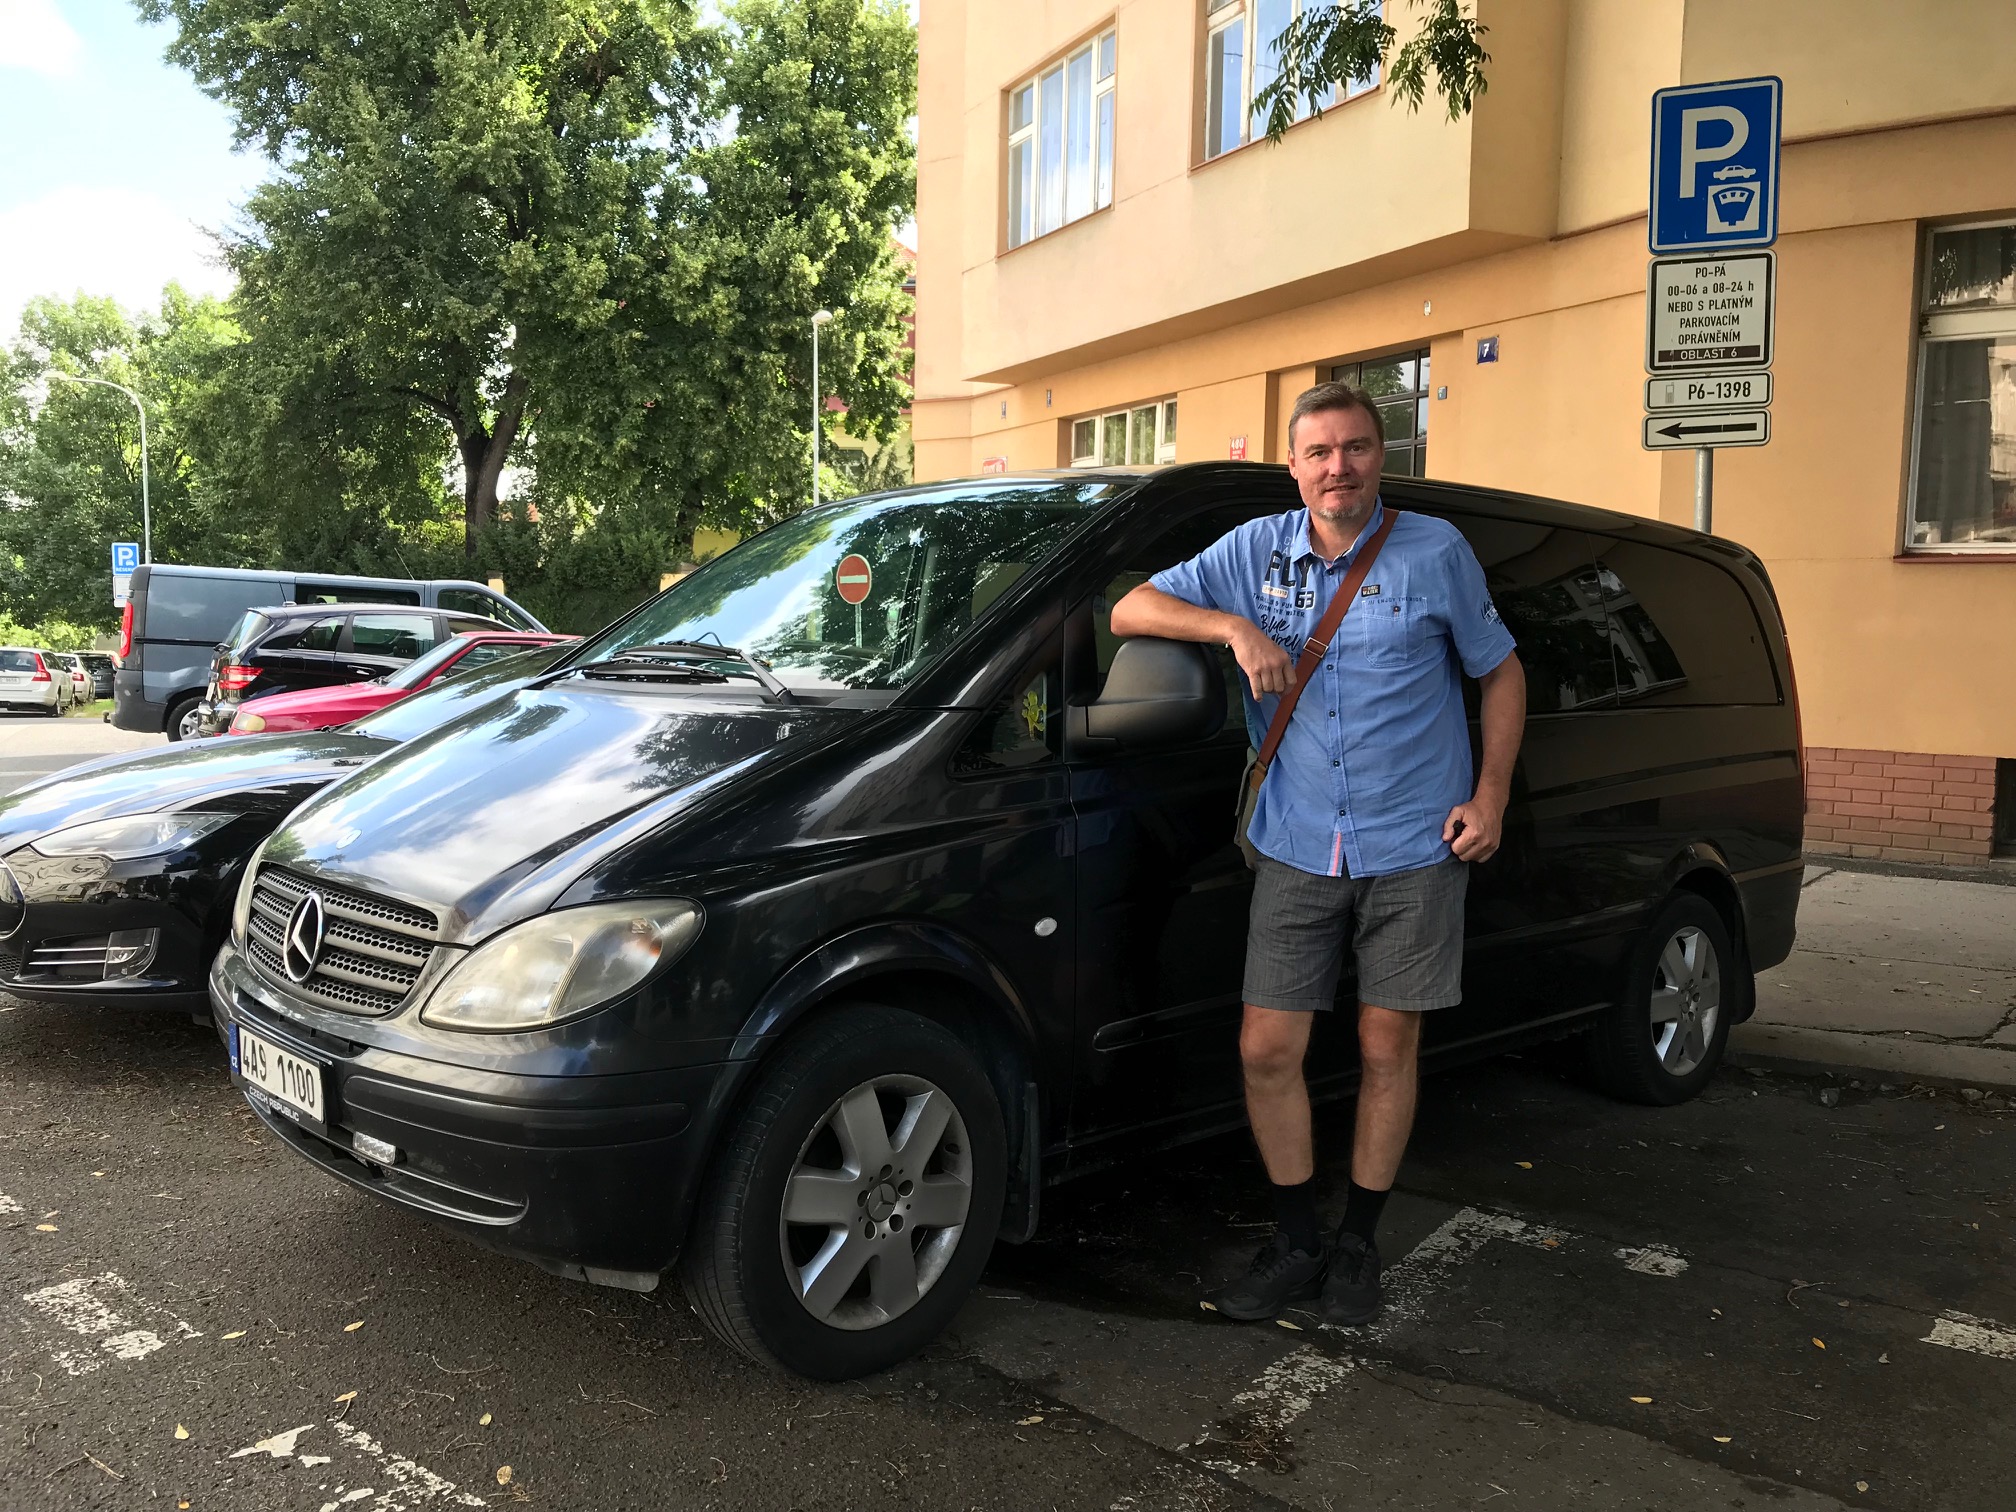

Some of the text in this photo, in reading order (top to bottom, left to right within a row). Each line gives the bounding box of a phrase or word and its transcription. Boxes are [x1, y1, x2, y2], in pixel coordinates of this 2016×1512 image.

[1679, 105, 1750, 199] P
[1695, 263, 1726, 278] PO-PÁ
[1667, 280, 1754, 297] 00-06 a 08-24 h
[1668, 295, 1753, 313] NEBO S PLATNÝM
[1680, 312, 1740, 329] PARKOVACÍM
[1678, 329, 1741, 346] OPRÁVNĚNÍM
[1483, 342, 1490, 358] 7
[1680, 347, 1738, 360] OBLAST 6
[1688, 381, 1751, 400] P6-1398
[117, 546, 133, 566] P
[1264, 549, 1314, 589] FLY
[1295, 590, 1315, 609] 63
[1260, 613, 1291, 634] Blue
[231, 1054, 238, 1068] CZ
[243, 1035, 315, 1108] 4A9 1100
[249, 1085, 299, 1122] CZECH REPUBLIC
